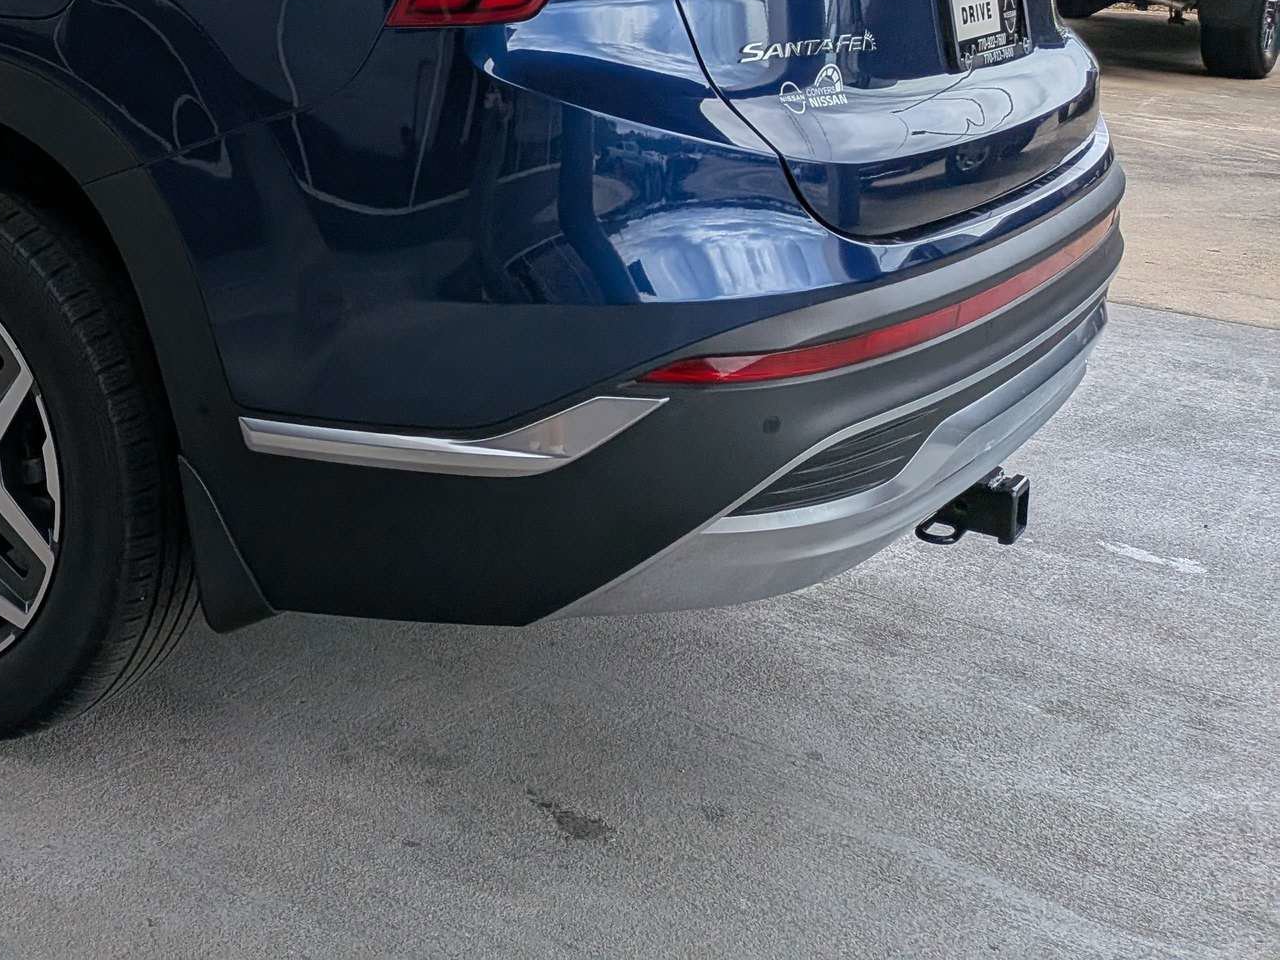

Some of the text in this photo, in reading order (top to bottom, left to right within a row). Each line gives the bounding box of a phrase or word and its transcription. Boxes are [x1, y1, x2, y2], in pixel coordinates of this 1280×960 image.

[961, 1, 992, 25] DRIVE
[806, 86, 836, 97] CONYERS
[780, 94, 806, 103] NISSAN
[808, 93, 848, 109] NISSAN
